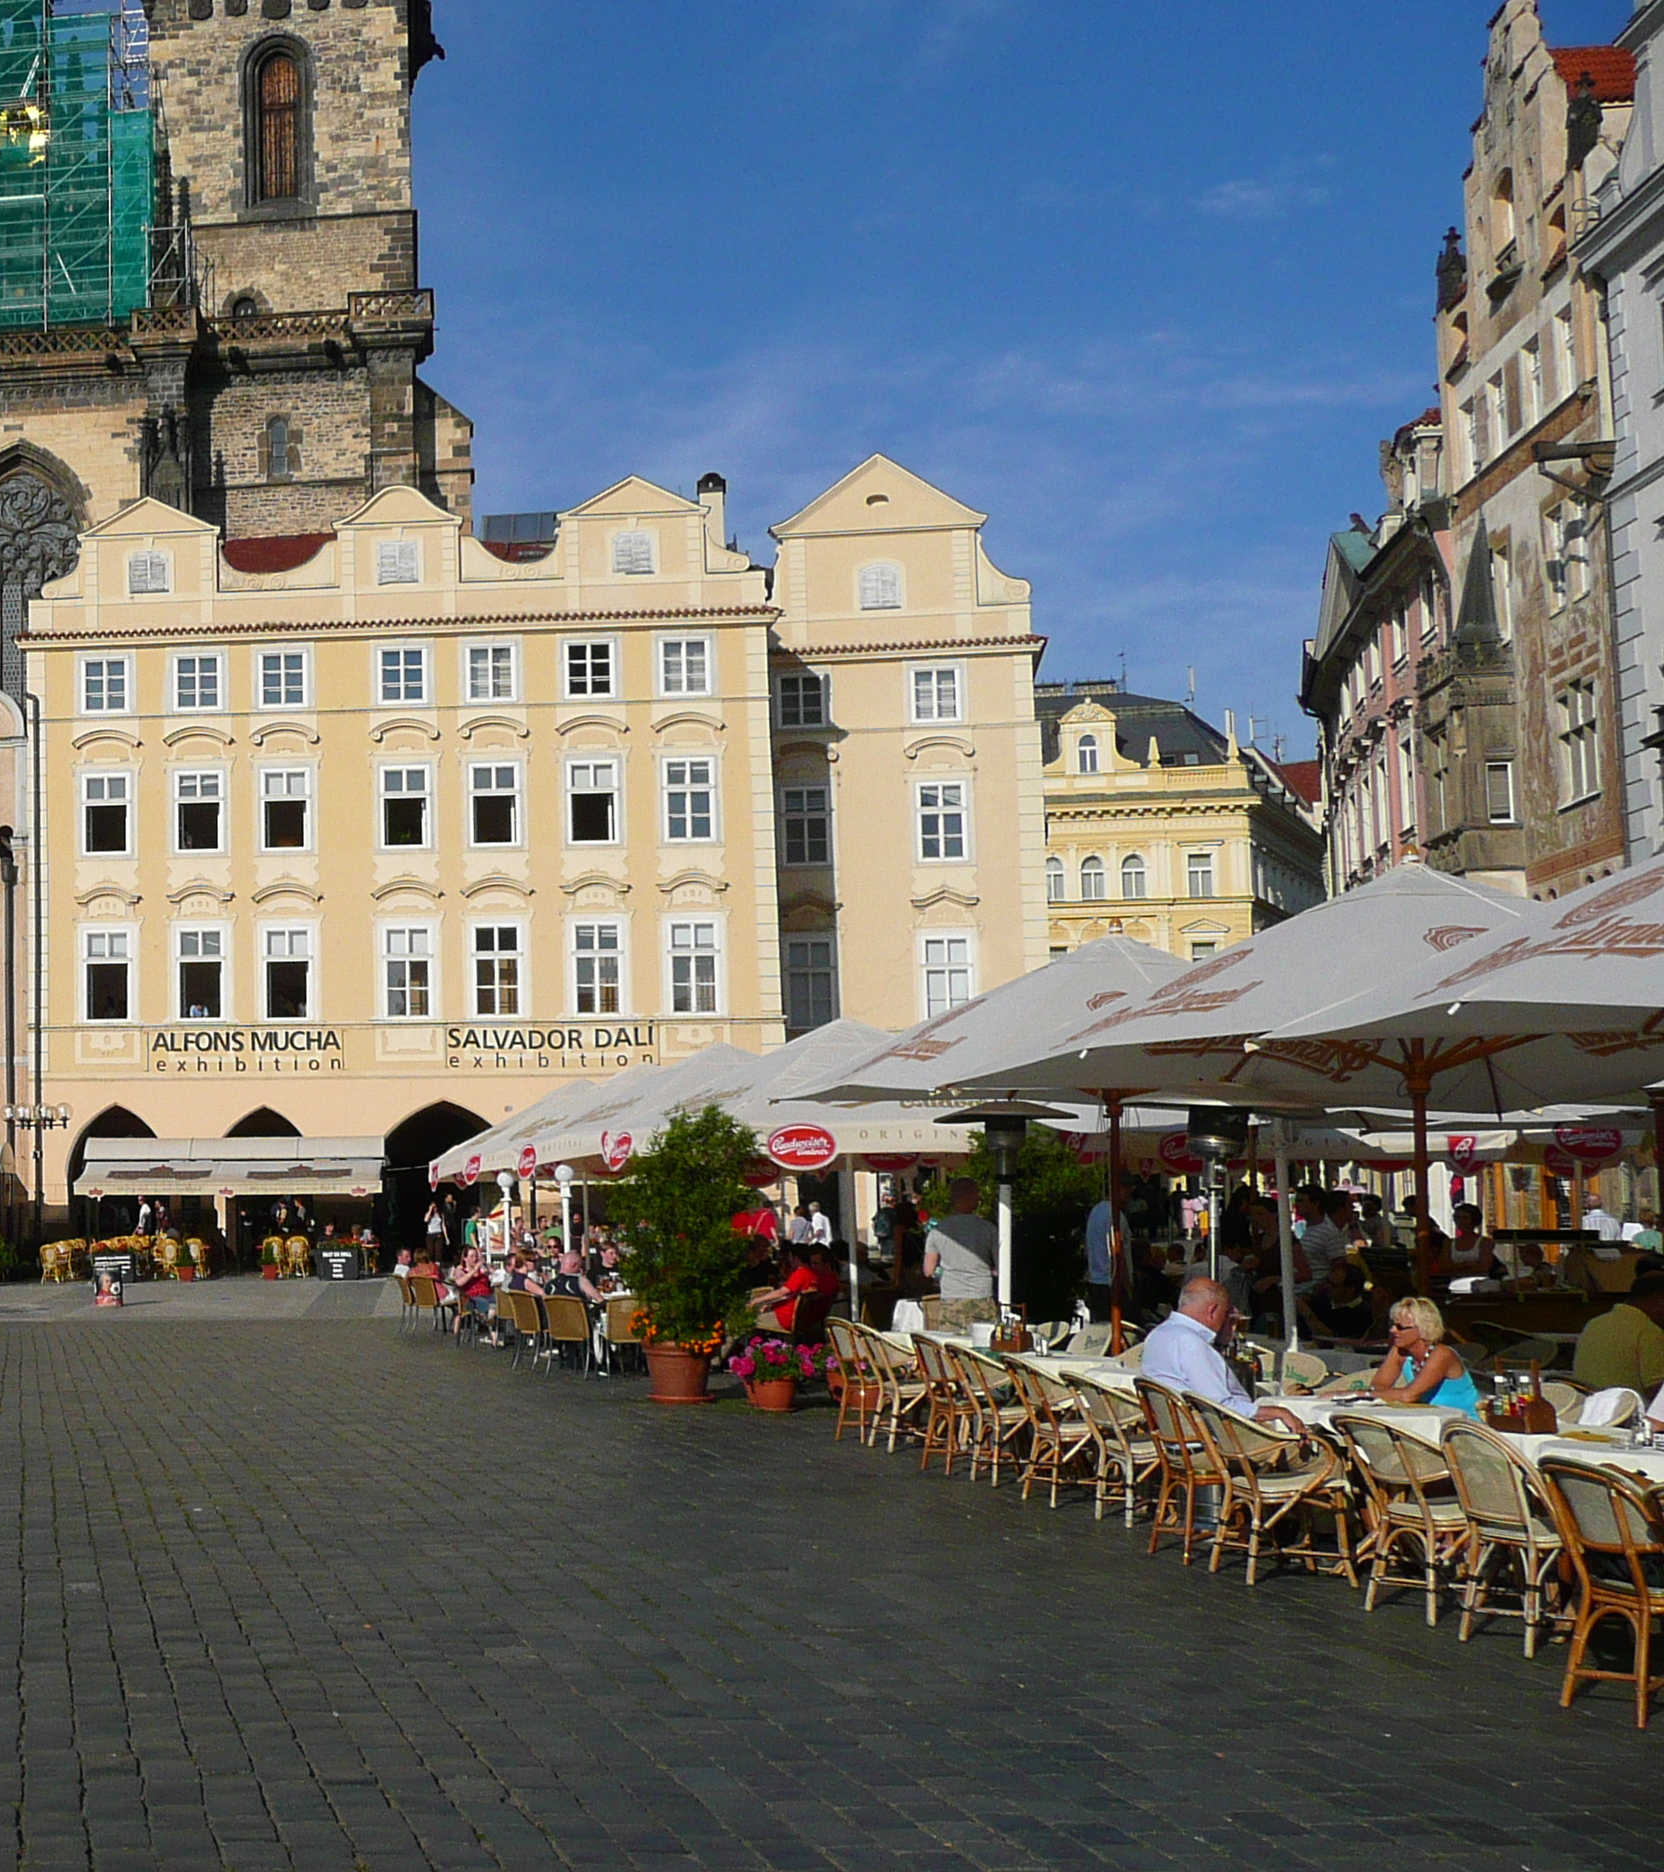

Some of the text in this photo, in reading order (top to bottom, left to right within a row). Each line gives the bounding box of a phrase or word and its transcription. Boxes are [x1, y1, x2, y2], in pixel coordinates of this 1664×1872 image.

[152, 1030, 341, 1052] ALFONS MUCHA
[447, 1019, 655, 1050] SALVADOR DALÍ
[156, 1055, 342, 1072] exhibition
[448, 1050, 653, 1069] exhibition
[859, 1128, 974, 1139] ORIGIN
